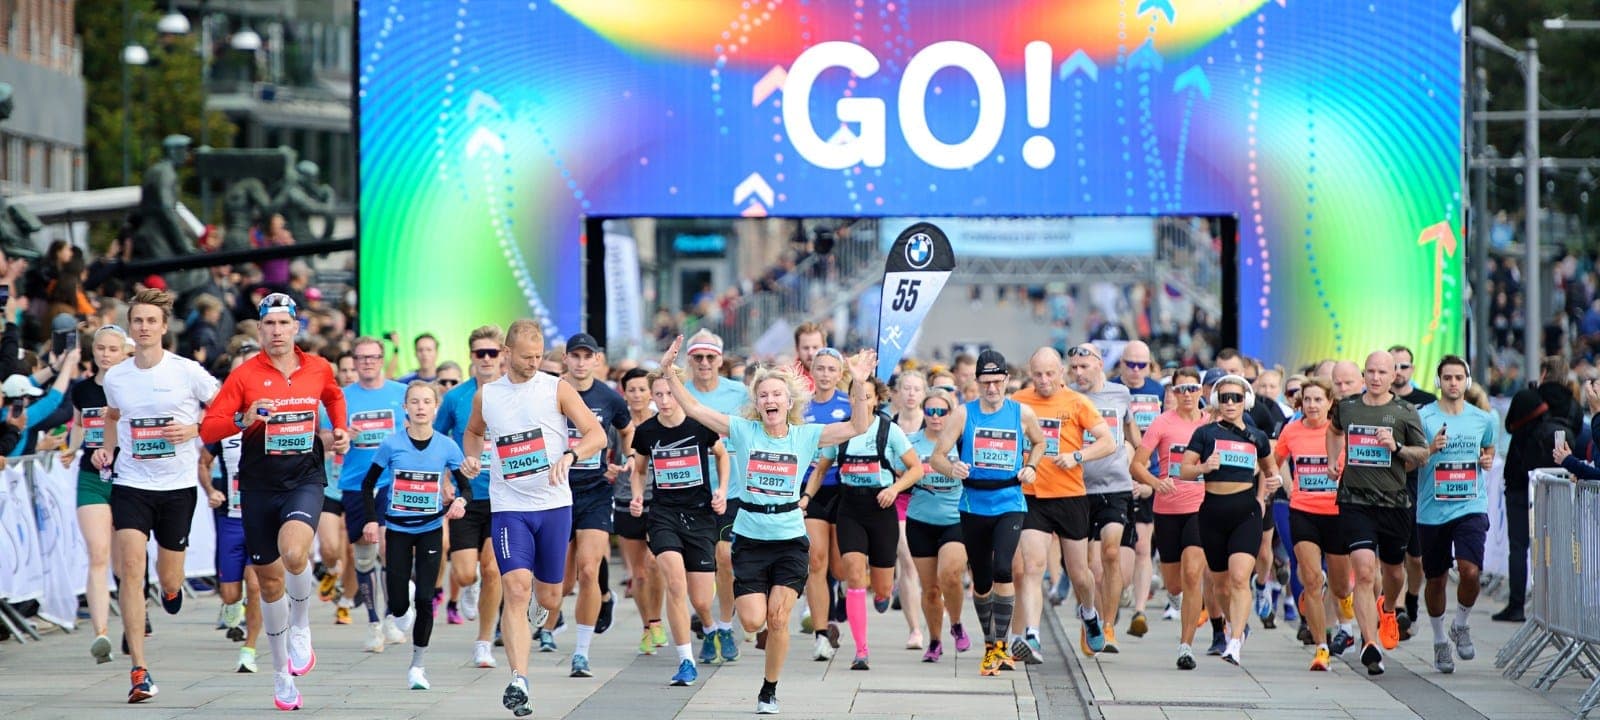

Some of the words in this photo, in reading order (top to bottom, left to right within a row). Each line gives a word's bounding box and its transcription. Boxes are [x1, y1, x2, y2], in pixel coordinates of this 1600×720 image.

[782, 40, 1056, 169] GO!
[892, 278, 922, 312] 55
[275, 396, 318, 407] Santander
[135, 442, 166, 451] 12340
[510, 444, 532, 454] FRANK
[508, 456, 539, 469] 12404
[1224, 454, 1249, 464] 12002
[757, 463, 789, 473] MARIANNE
[758, 476, 785, 487] 12817
[402, 494, 430, 504] 12093
